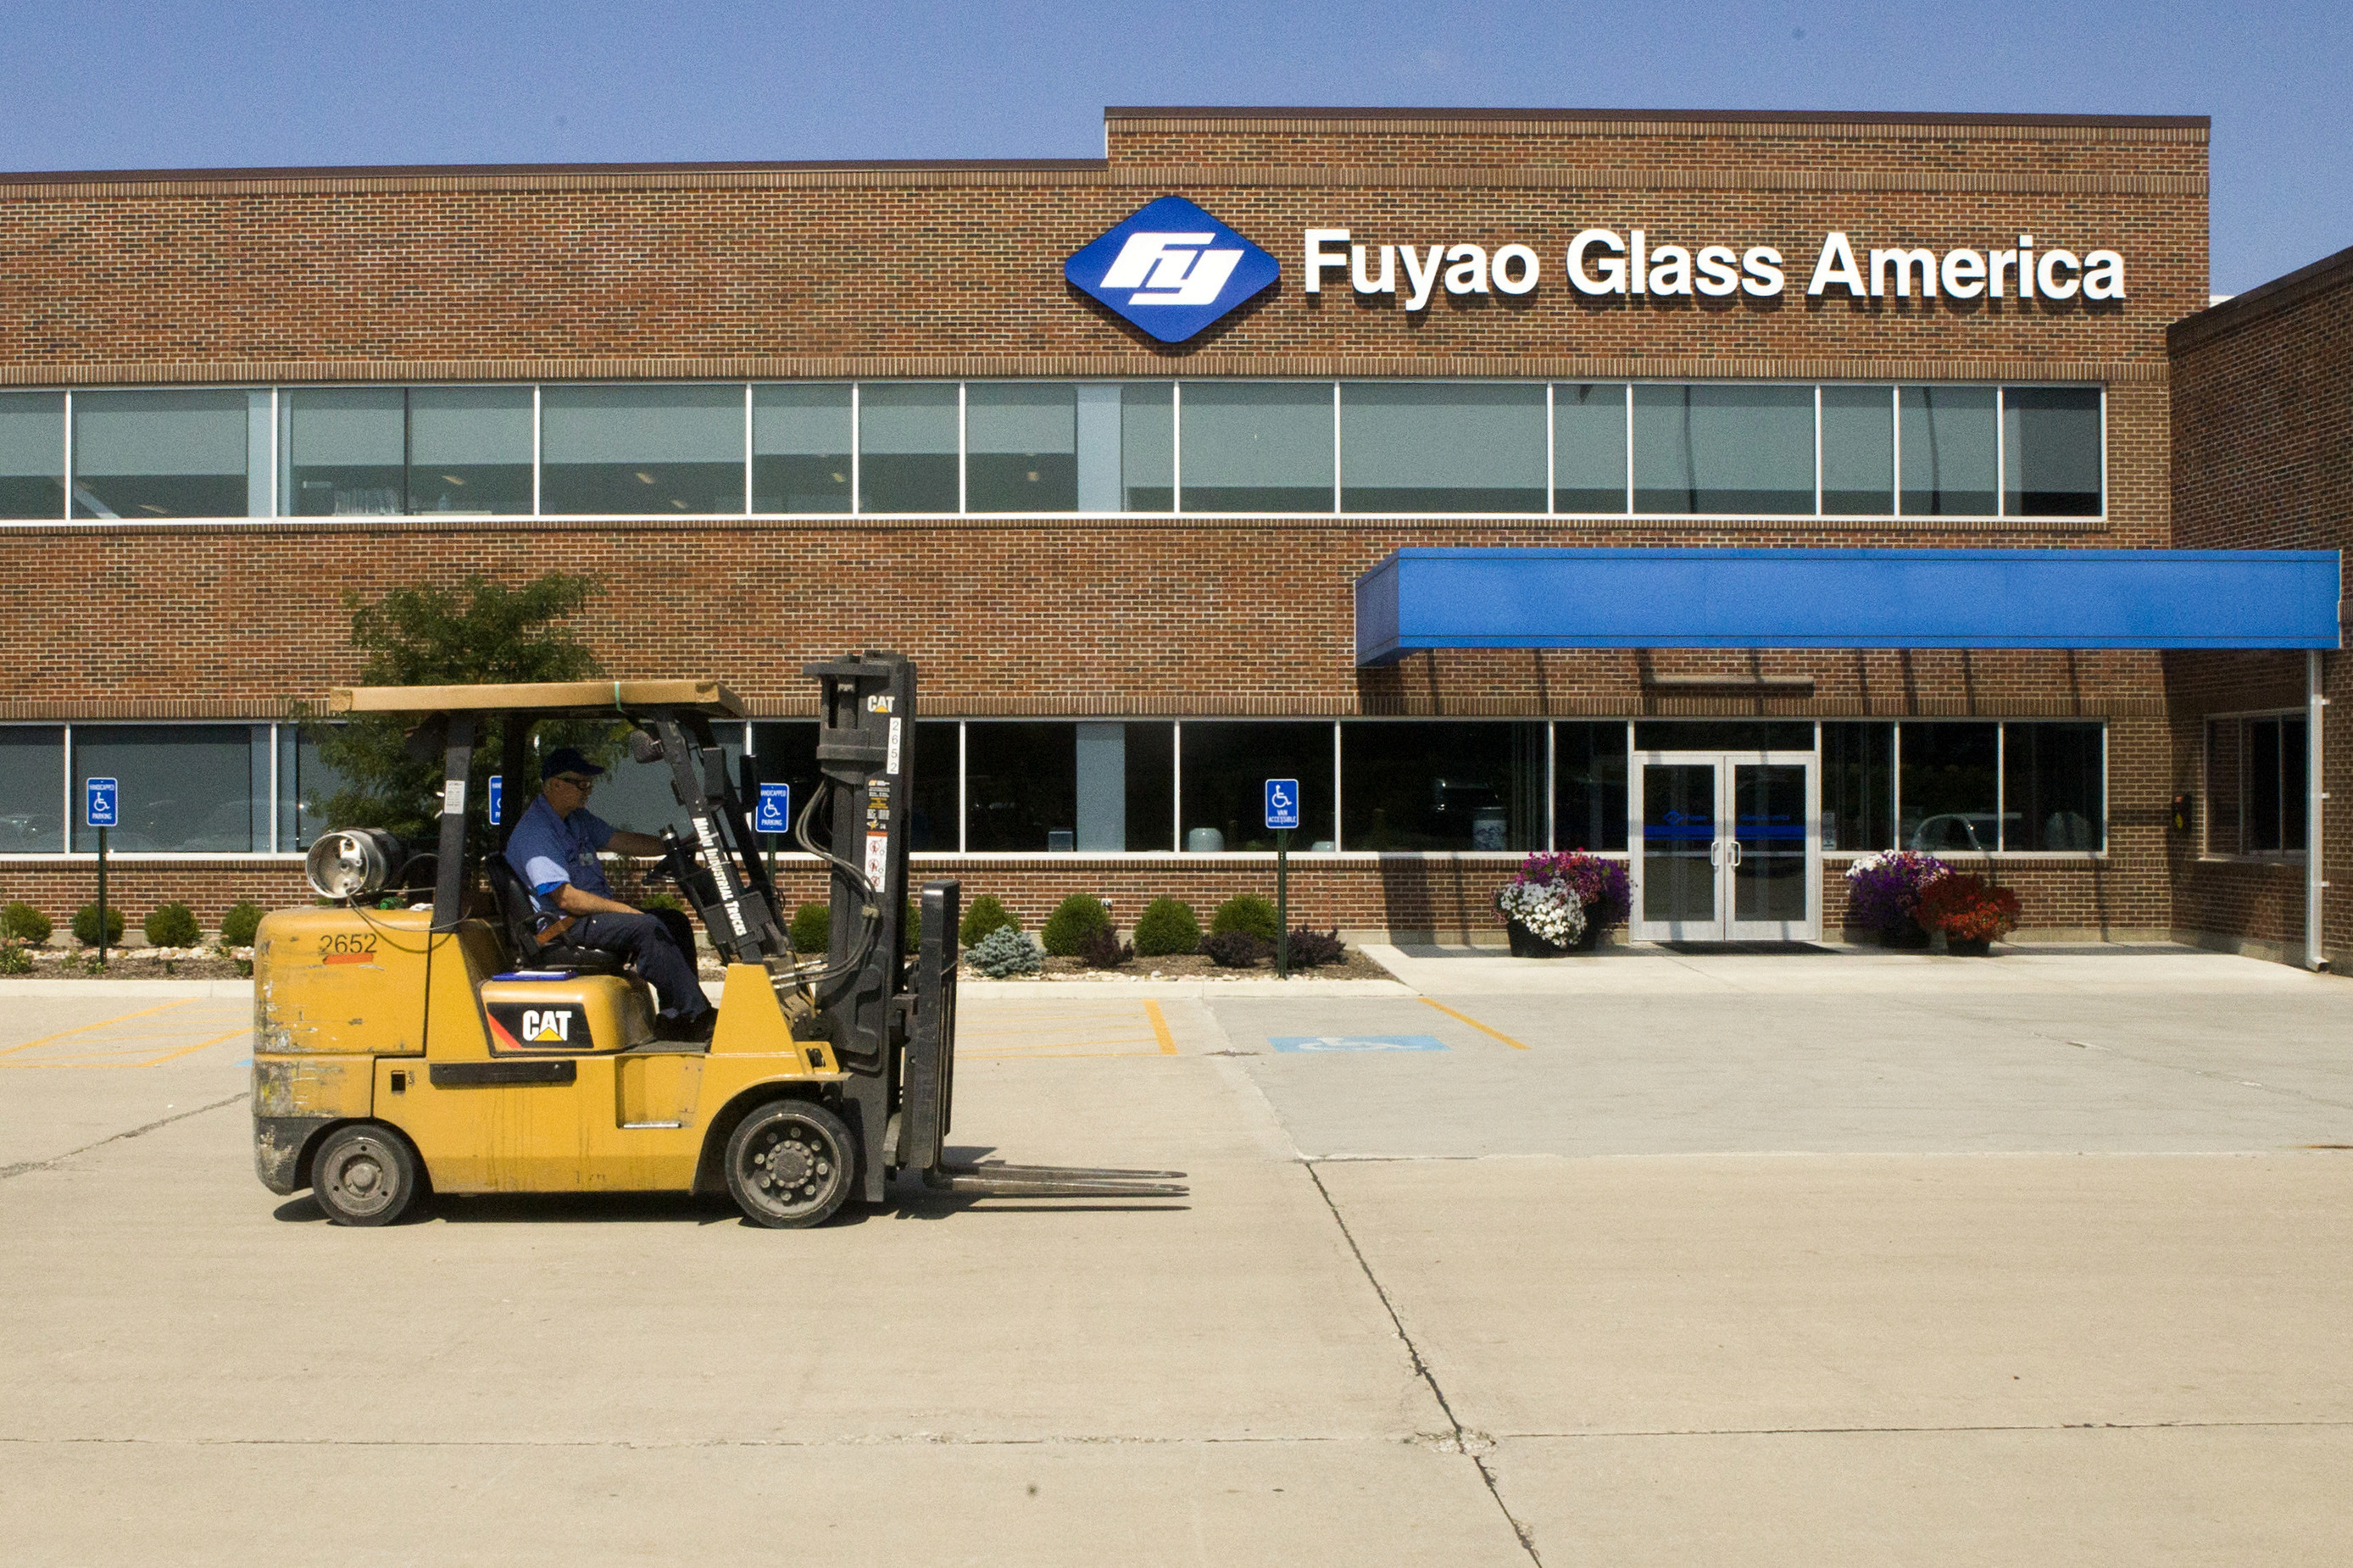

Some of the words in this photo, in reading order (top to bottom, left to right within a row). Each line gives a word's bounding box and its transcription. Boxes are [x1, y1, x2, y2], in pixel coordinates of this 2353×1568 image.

[1304, 228, 1539, 311] Fuyao
[1566, 228, 1784, 297] Glass
[1807, 232, 2126, 299] America
[867, 695, 895, 713] CAT
[890, 720, 899, 772] 2652
[704, 848, 734, 900] INDUSTRIAL
[724, 900, 748, 937] TRUCKS
[319, 933, 377, 954] 2652
[522, 1009, 572, 1042] CAT
